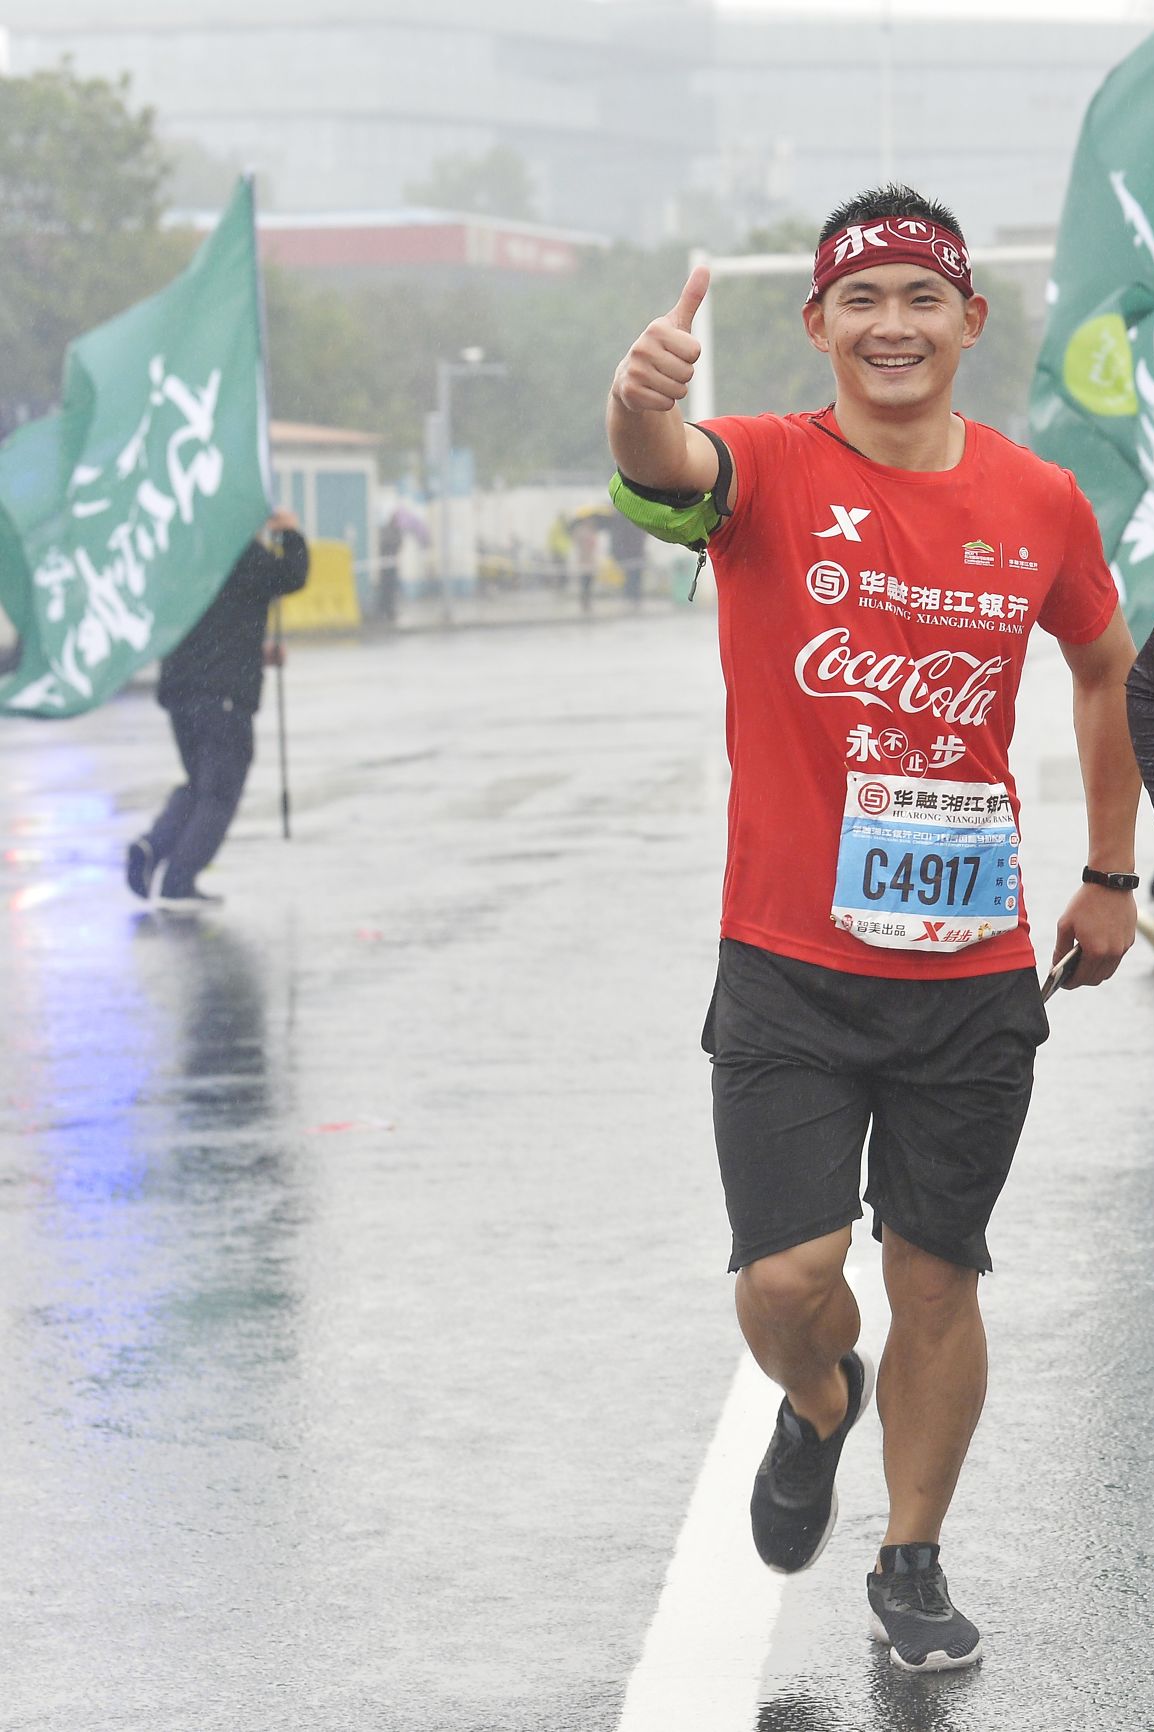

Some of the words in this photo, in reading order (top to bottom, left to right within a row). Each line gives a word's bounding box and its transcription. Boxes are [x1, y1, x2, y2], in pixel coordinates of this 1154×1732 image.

[859, 570, 1028, 622] 华融湘江银行
[916, 613, 995, 631] XIANGJIANG
[999, 623, 1024, 635] BANK
[795, 627, 1011, 726] Coca-Cola
[892, 810, 941, 822] HUARONG
[993, 815, 1014, 824] BANK
[862, 847, 981, 906] C4917
[856, 919, 906, 937] 智美出品
